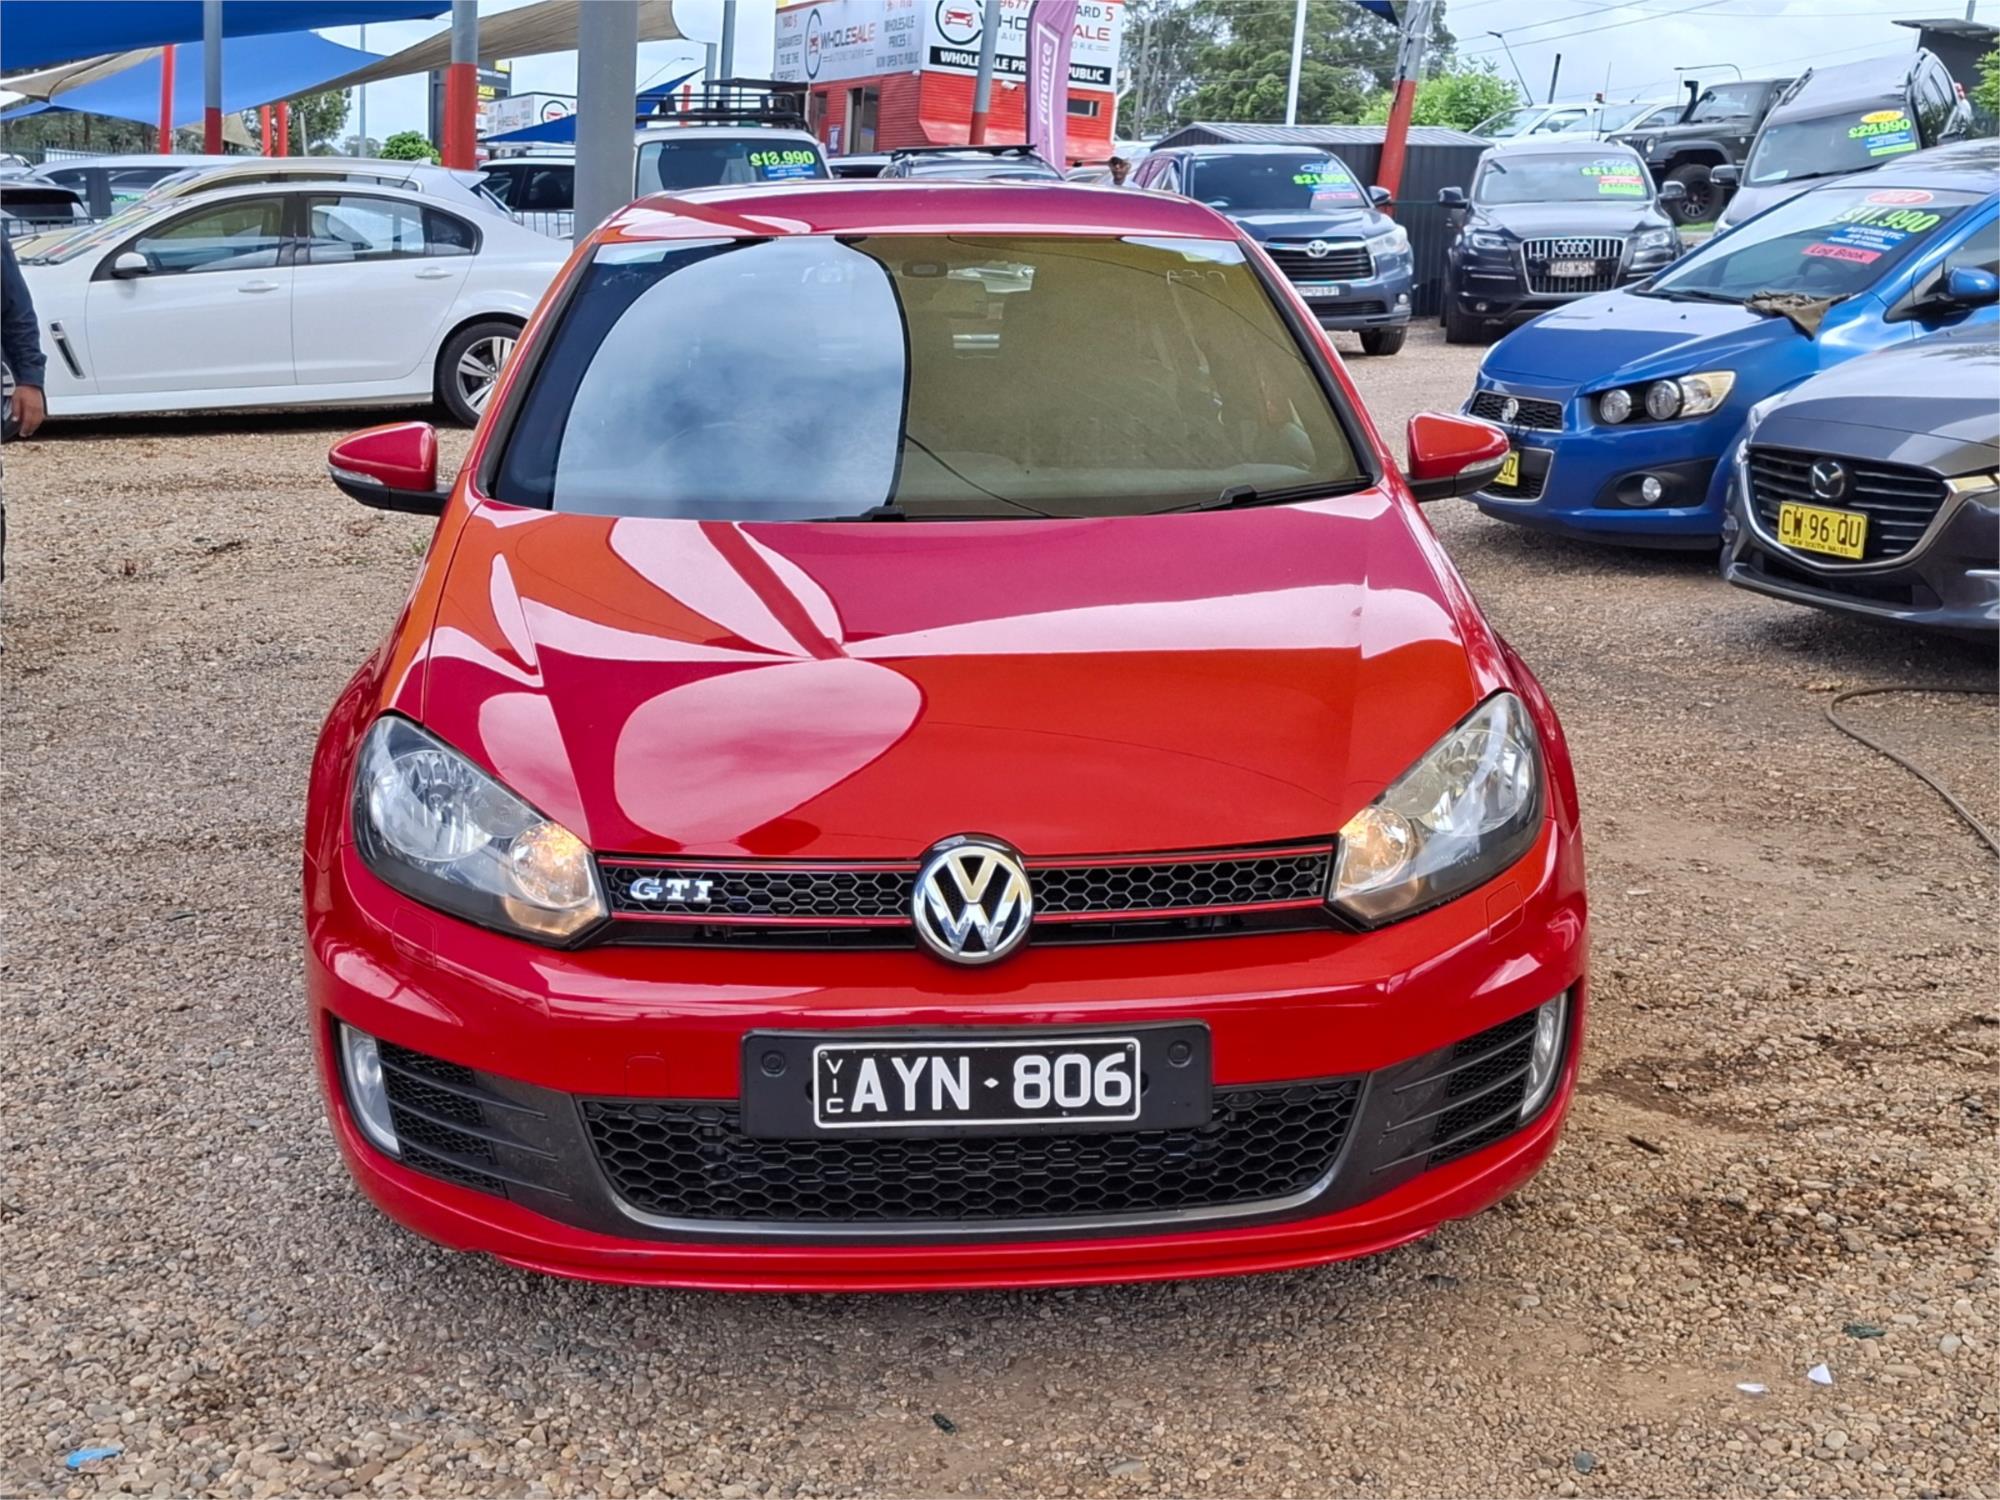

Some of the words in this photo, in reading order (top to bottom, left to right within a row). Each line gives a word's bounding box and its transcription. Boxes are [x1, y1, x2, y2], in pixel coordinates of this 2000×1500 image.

[1076, 6, 1100, 18] ARD
[1105, 6, 1113, 21] 5
[820, 22, 876, 49] WHOLESALE
[630, 877, 713, 904] GTI
[825, 1058, 845, 1114] VIC
[1013, 1052, 1132, 1110] 806
